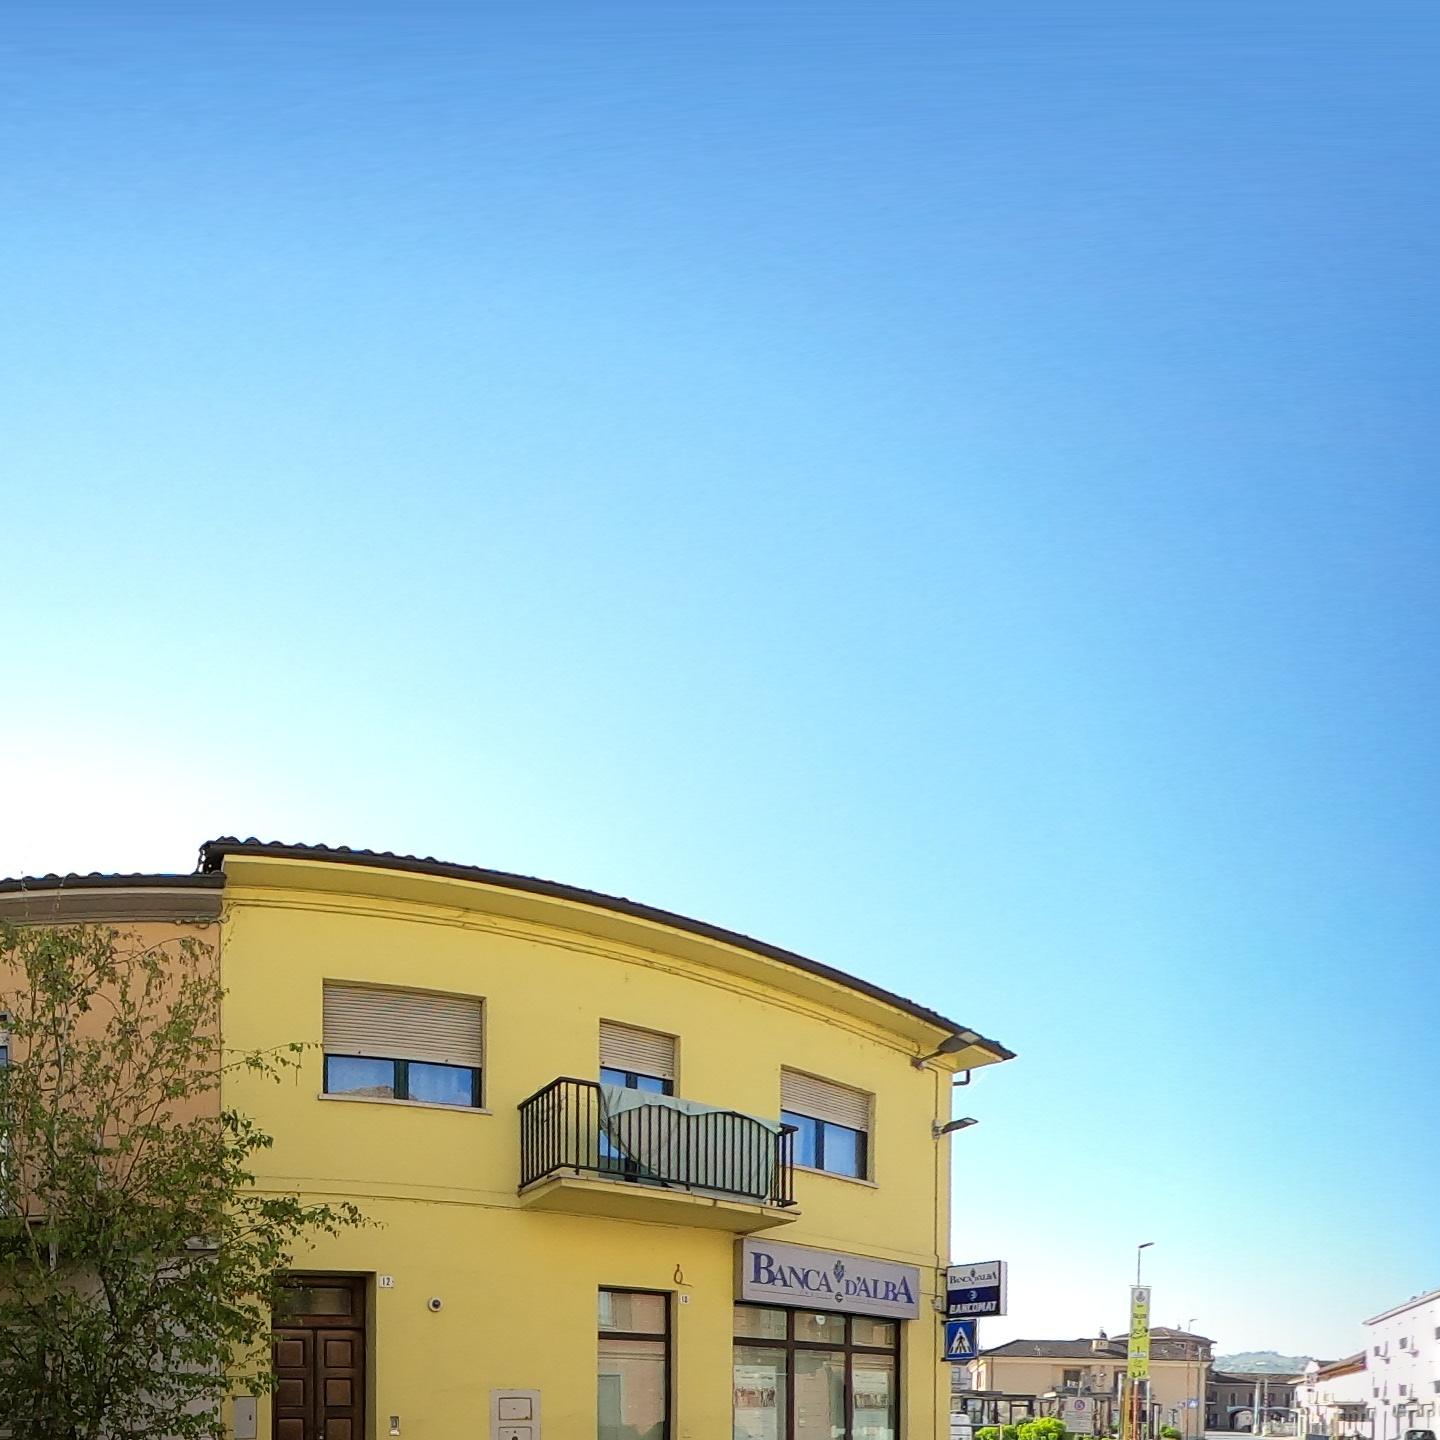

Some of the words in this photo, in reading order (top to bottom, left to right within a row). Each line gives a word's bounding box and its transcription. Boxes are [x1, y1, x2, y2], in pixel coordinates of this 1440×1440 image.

[750, 1251, 833, 1293] BANCA
[844, 1275, 915, 1304] D'ALBA
[949, 1301, 997, 1315] BANCOMAT
